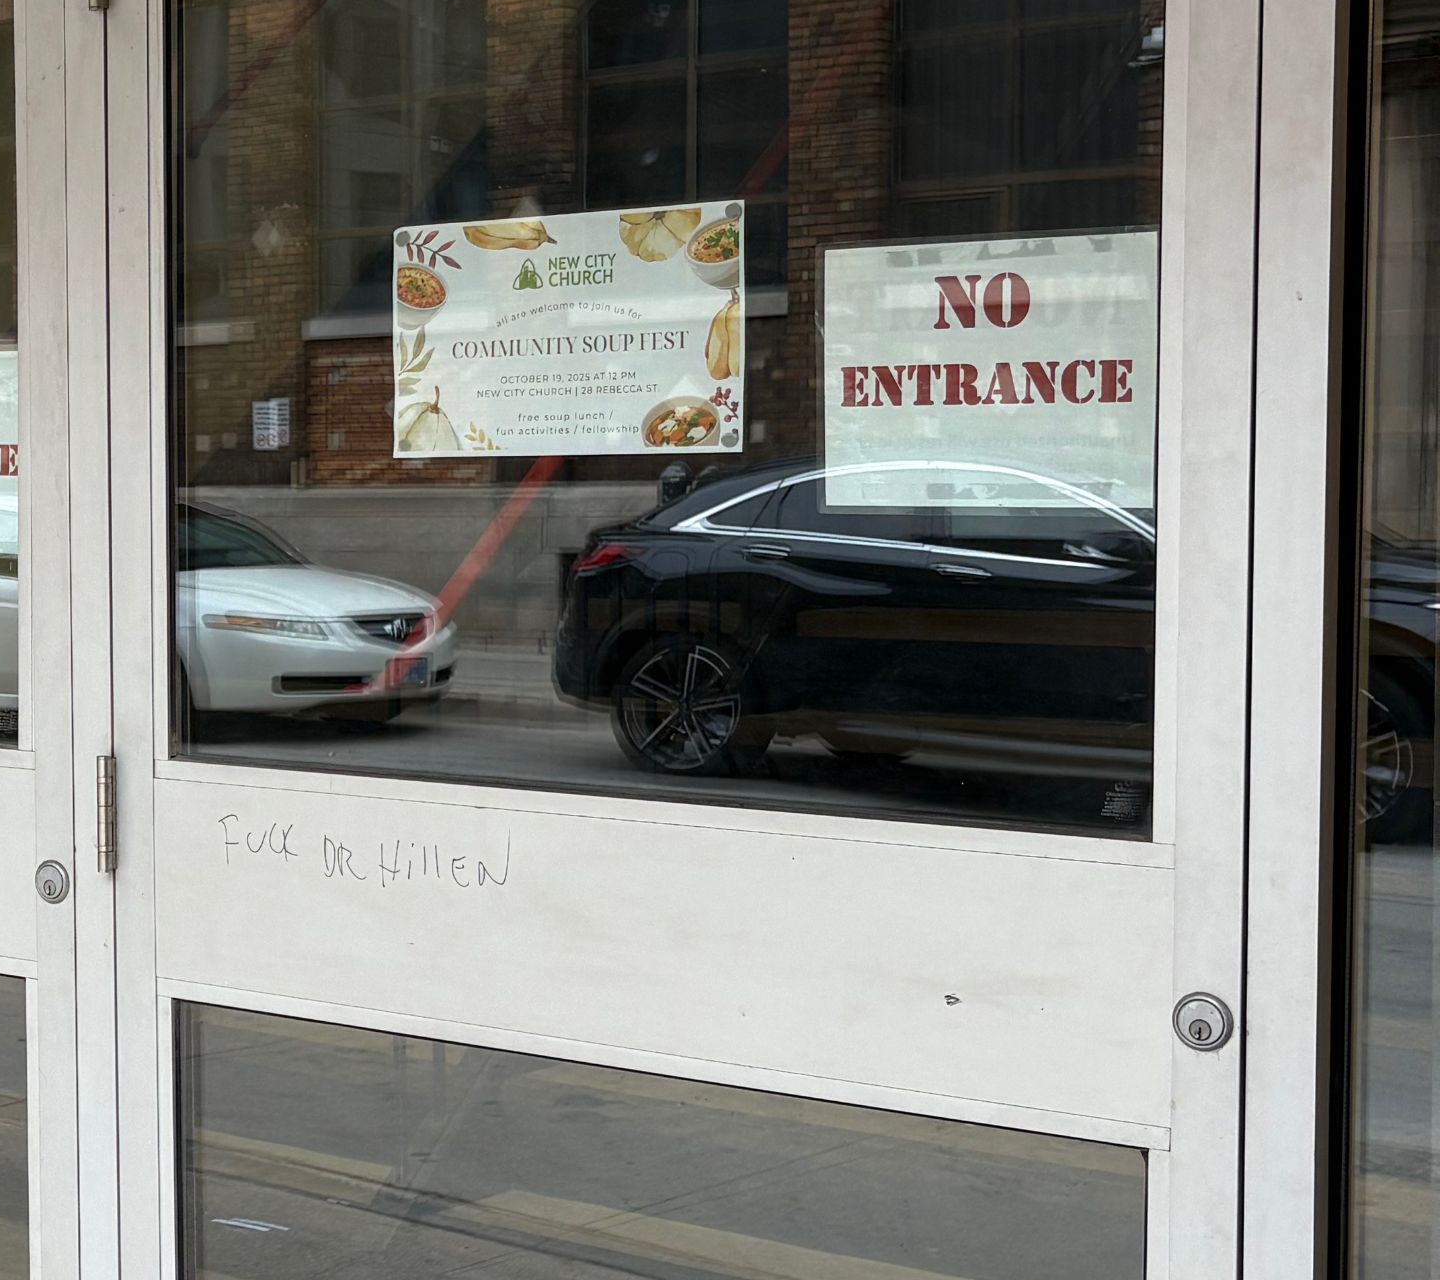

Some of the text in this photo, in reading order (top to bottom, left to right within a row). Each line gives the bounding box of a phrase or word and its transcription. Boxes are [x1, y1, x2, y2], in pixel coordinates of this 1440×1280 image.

[548, 253, 617, 271] NEW CITY
[548, 269, 614, 288] CHURCH
[934, 272, 1031, 329] NO
[496, 315, 508, 328] all
[530, 301, 575, 315] welcome
[578, 301, 589, 310] to
[591, 302, 611, 312] join
[614, 306, 625, 316] us
[628, 308, 642, 320] for
[452, 330, 690, 360] COMMUNITY SOUP FEST
[500, 370, 637, 384] OCTOBER 19, 2025 AT 12 PM
[841, 359, 1134, 407] ENTRANCE
[476, 388, 501, 399] NEW
[503, 388, 526, 398] CITY
[528, 386, 572, 397] CHURCH
[581, 385, 593, 395] 28
[596, 383, 643, 395] REBECCA
[518, 412, 540, 422] free
[544, 411, 570, 422] soup
[574, 410, 605, 421] lunch
[496, 427, 514, 436] fun
[518, 425, 570, 436] activities
[582, 424, 640, 434] fellowship
[323, 834, 367, 880] DR
